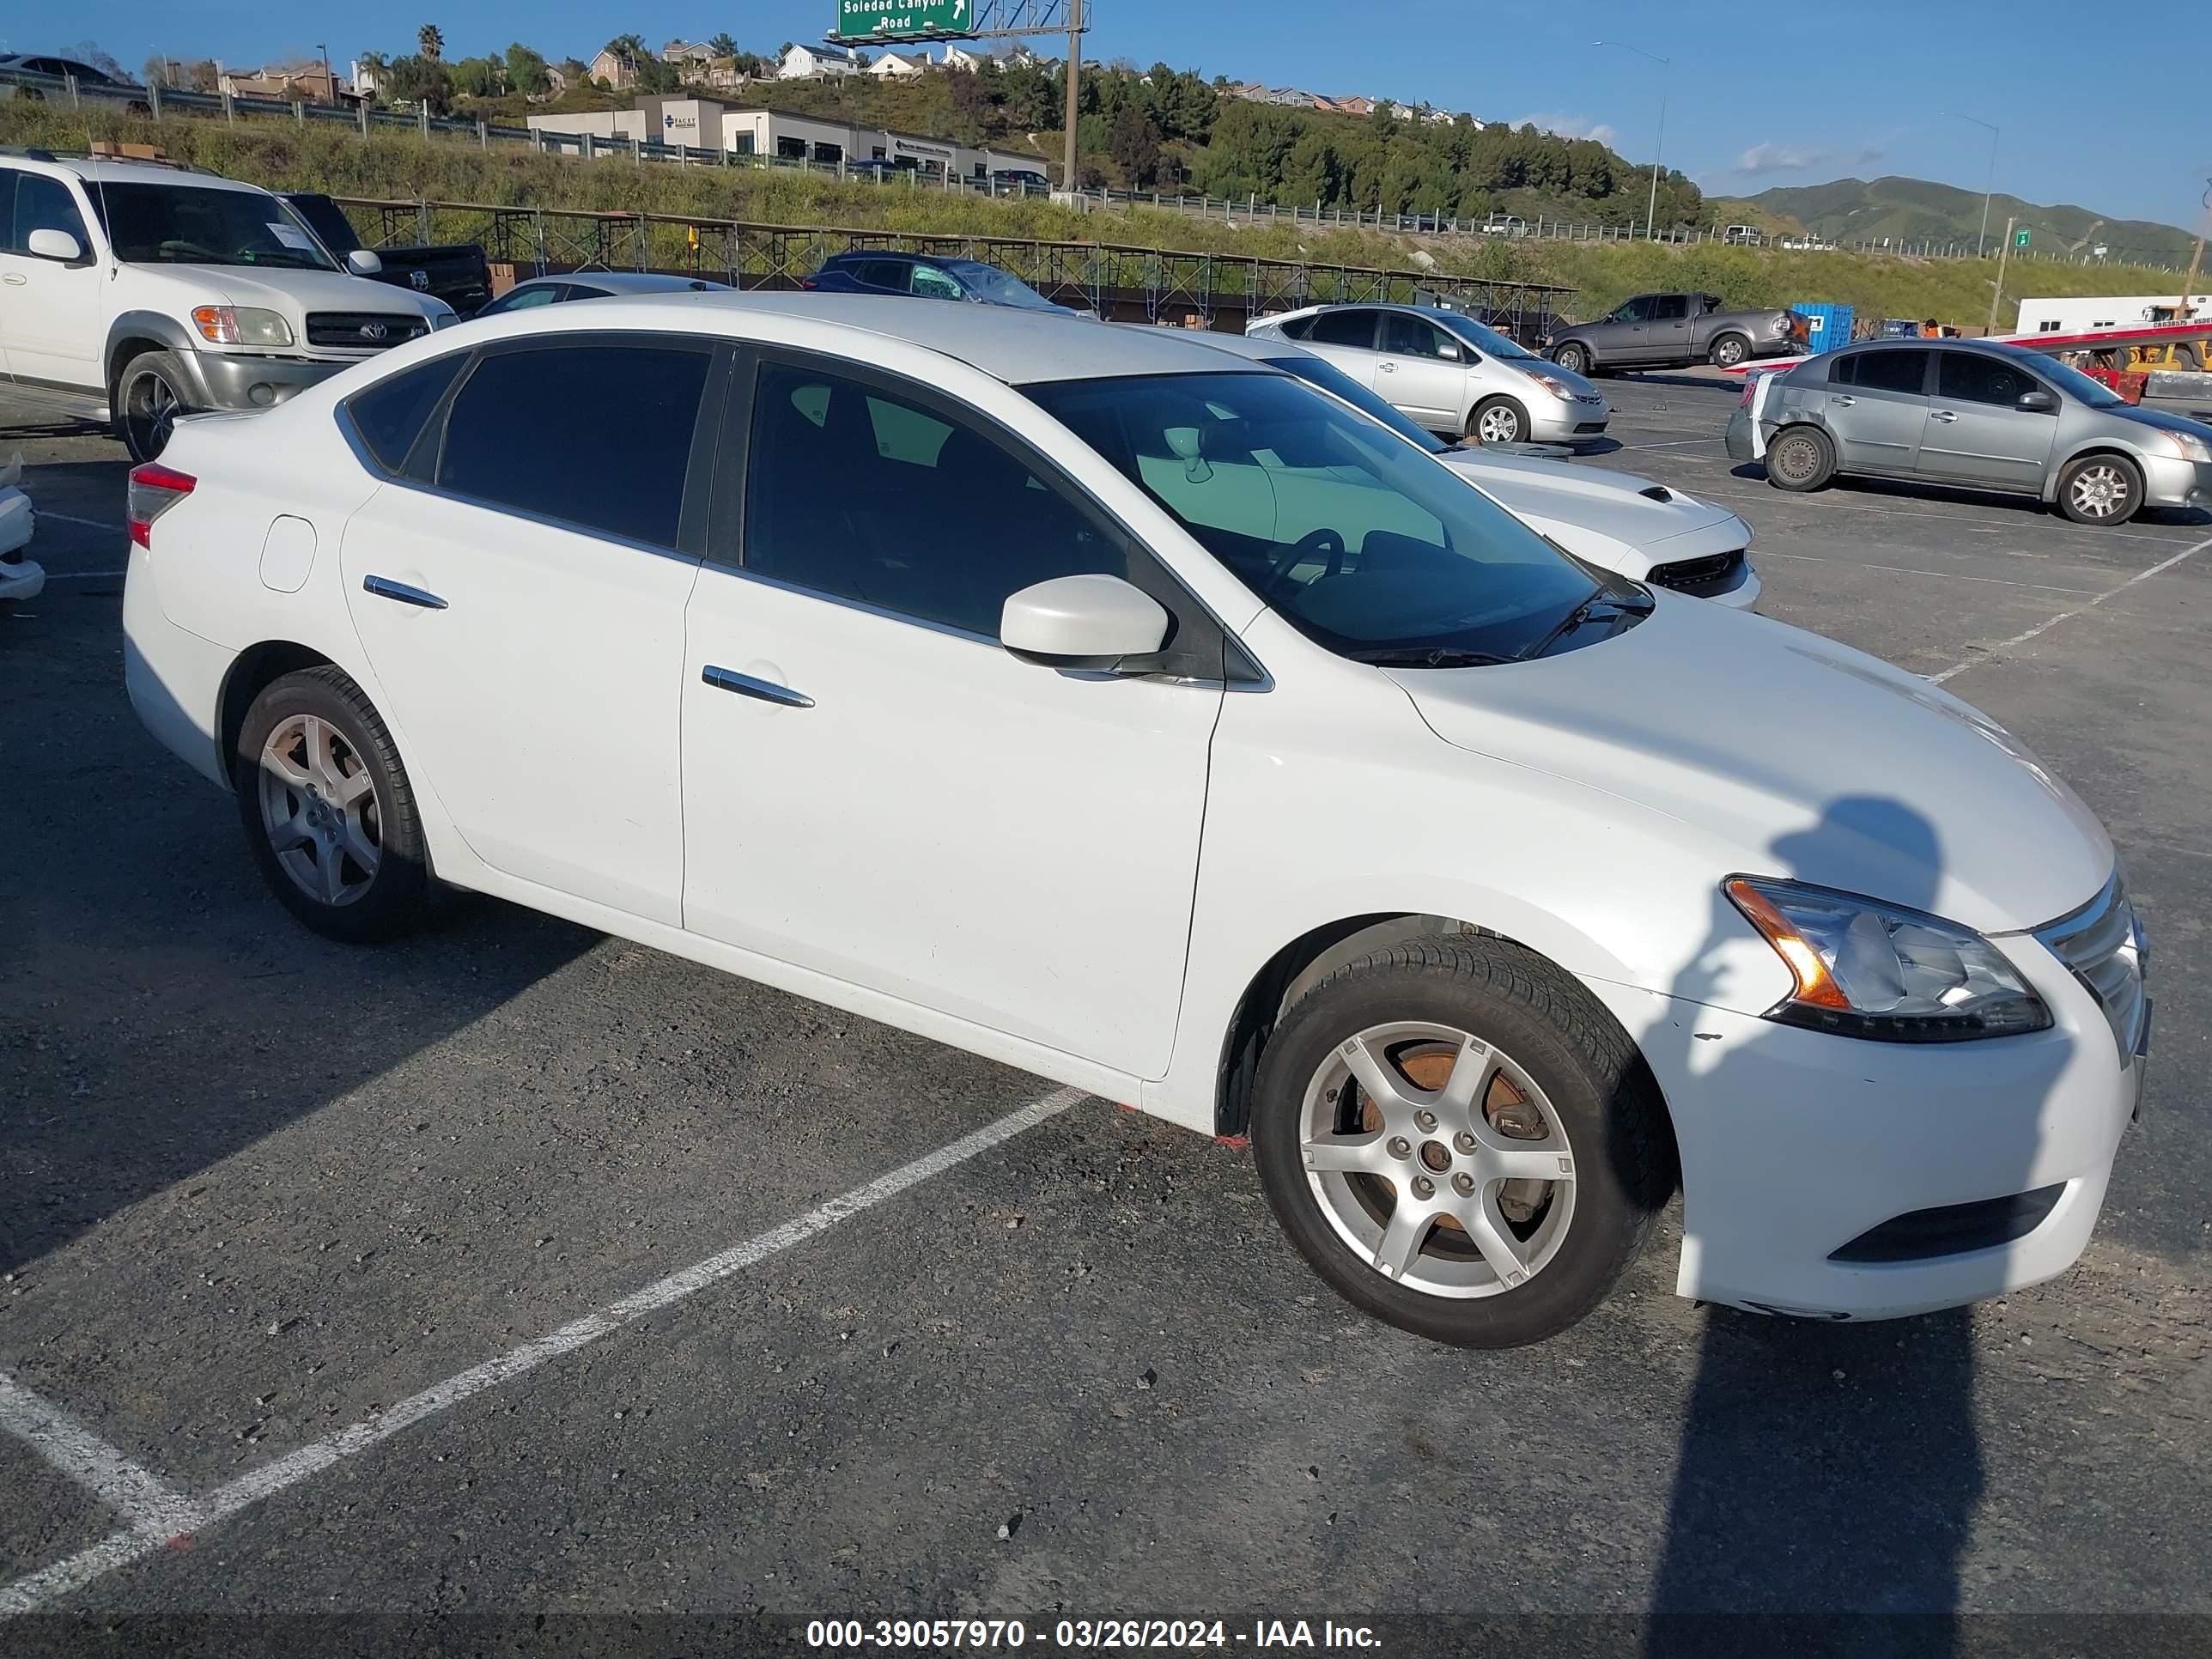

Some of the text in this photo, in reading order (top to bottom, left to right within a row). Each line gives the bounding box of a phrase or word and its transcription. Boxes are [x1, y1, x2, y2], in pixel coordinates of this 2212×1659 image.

[844, 0, 944, 13] Soledad Canyon
[881, 15, 911, 28] Road
